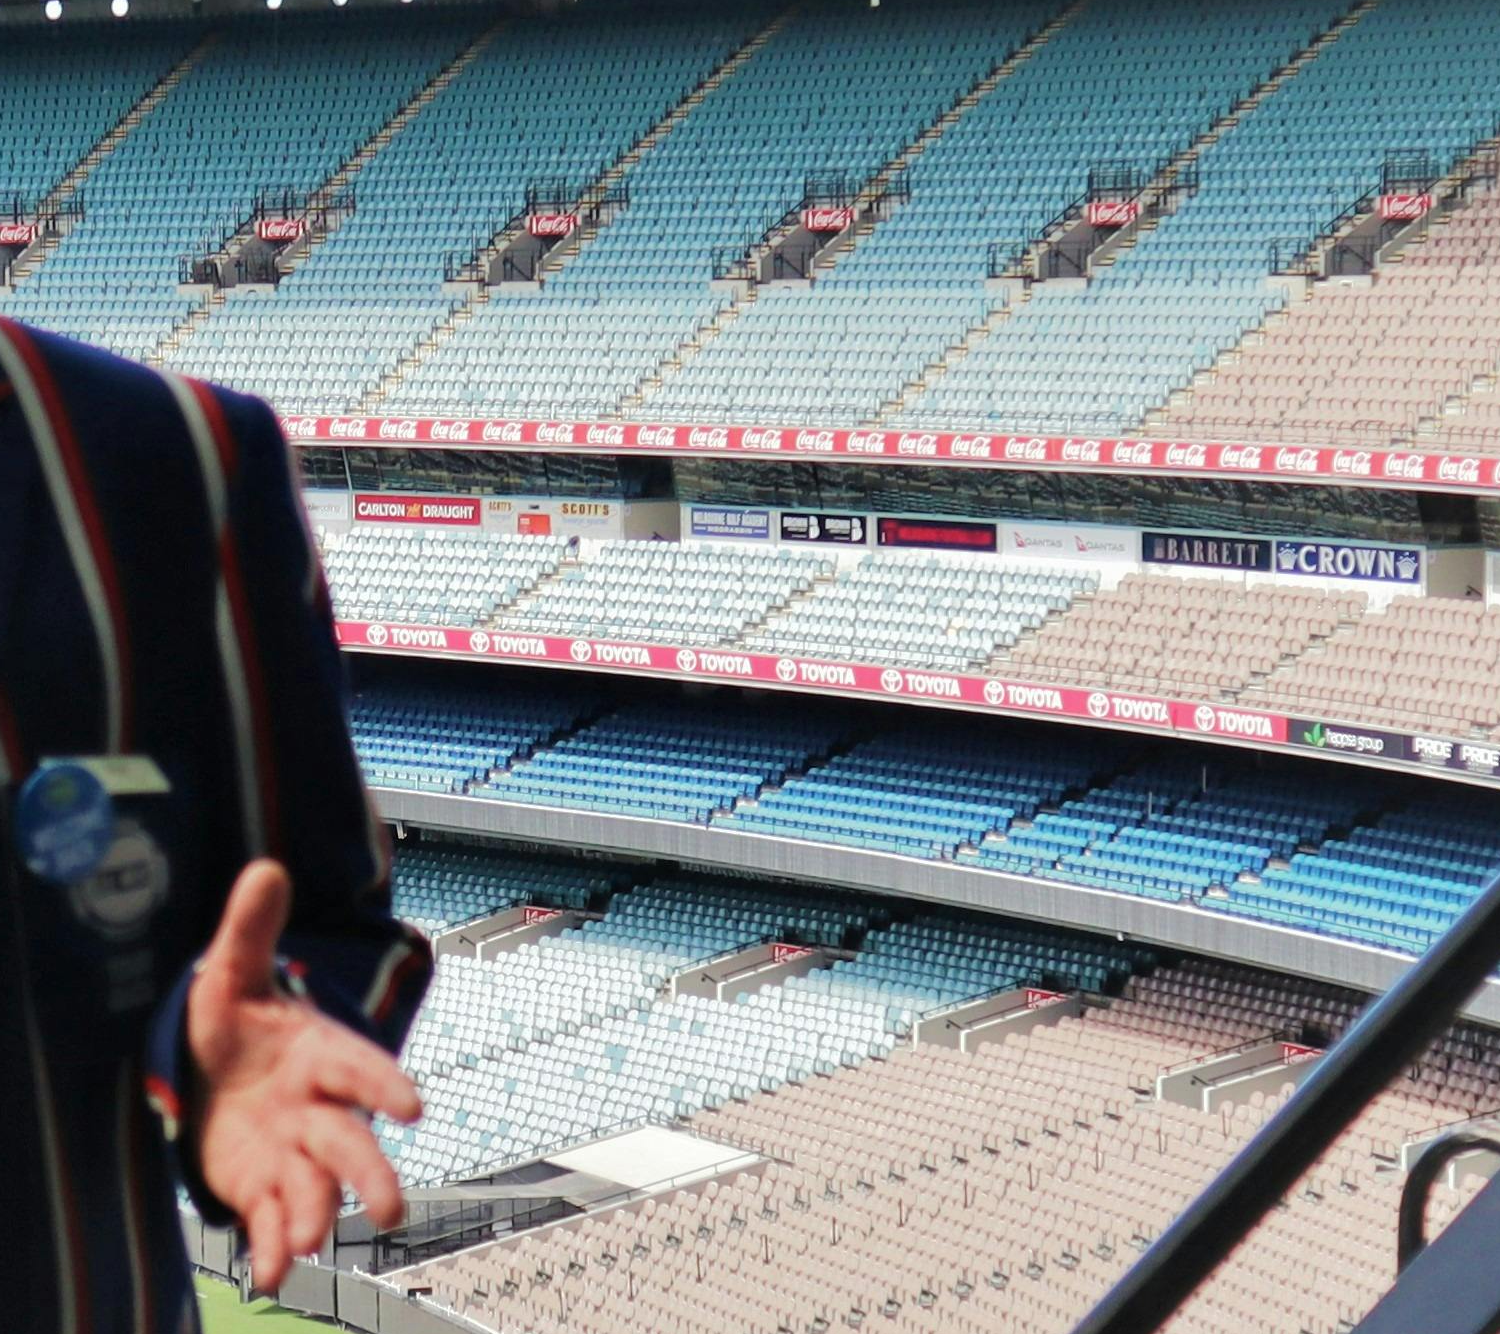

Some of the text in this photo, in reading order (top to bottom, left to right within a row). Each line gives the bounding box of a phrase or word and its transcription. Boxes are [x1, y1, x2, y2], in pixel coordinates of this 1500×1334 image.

[358, 502, 405, 517] CARLTON
[422, 504, 475, 519] DRAUGHT
[1168, 538, 1260, 567] BARRETT
[1299, 545, 1396, 579] CROWN
[390, 628, 447, 647] TOYOTA
[493, 637, 547, 656] TOYOTA
[594, 645, 650, 665] TOYOTA
[699, 654, 753, 674] TOYOTA
[800, 663, 855, 685] TOYOTA
[906, 674, 961, 696] TOYOTA
[1007, 685, 1063, 709] TOYOTA
[1218, 711, 1272, 737] TOYOTA
